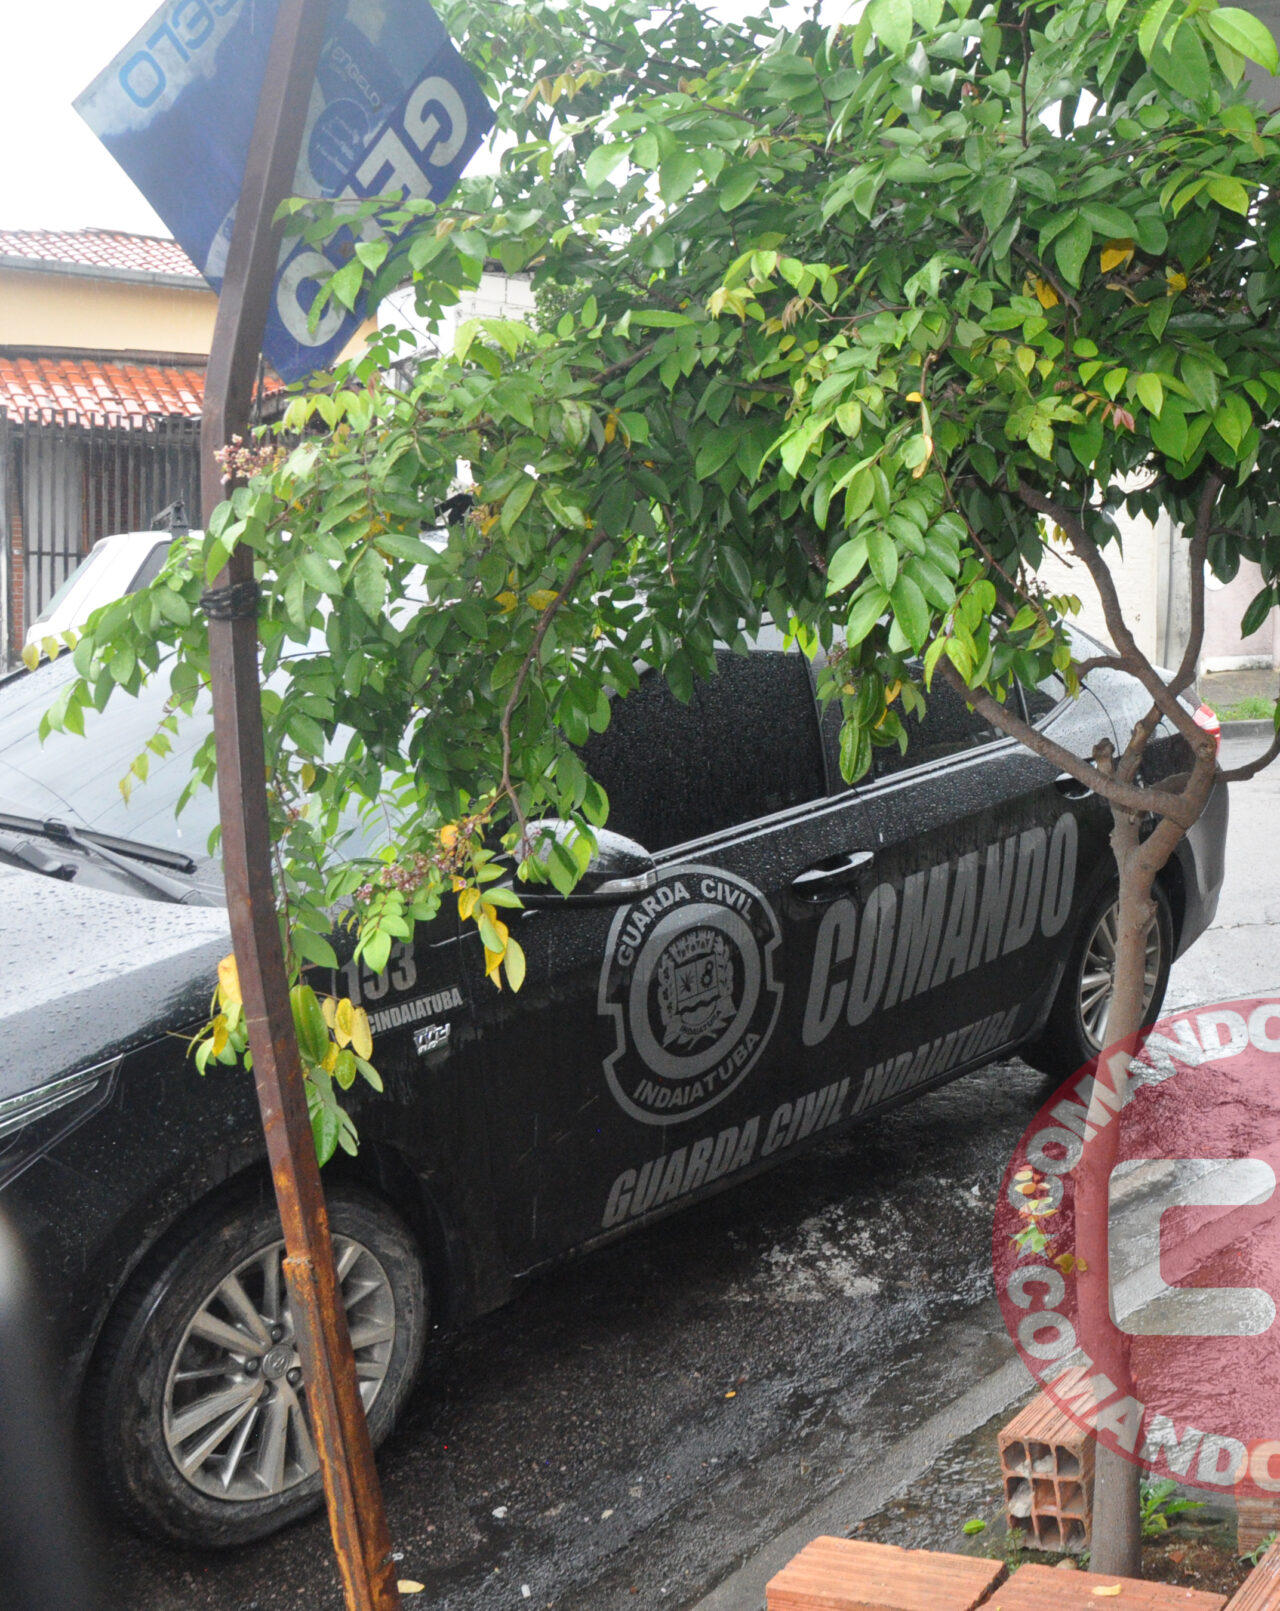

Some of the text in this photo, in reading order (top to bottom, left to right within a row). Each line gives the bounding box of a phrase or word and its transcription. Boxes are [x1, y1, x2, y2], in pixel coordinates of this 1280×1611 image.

[118, 0, 241, 109] ELO
[616, 878, 753, 967] GUARDA CIVIL
[802, 812, 1079, 1047] COMANDO
[602, 1003, 1022, 1228] GUARDA CIVIL INDAIATUBA
[632, 1032, 762, 1109] INDAIATUBA
